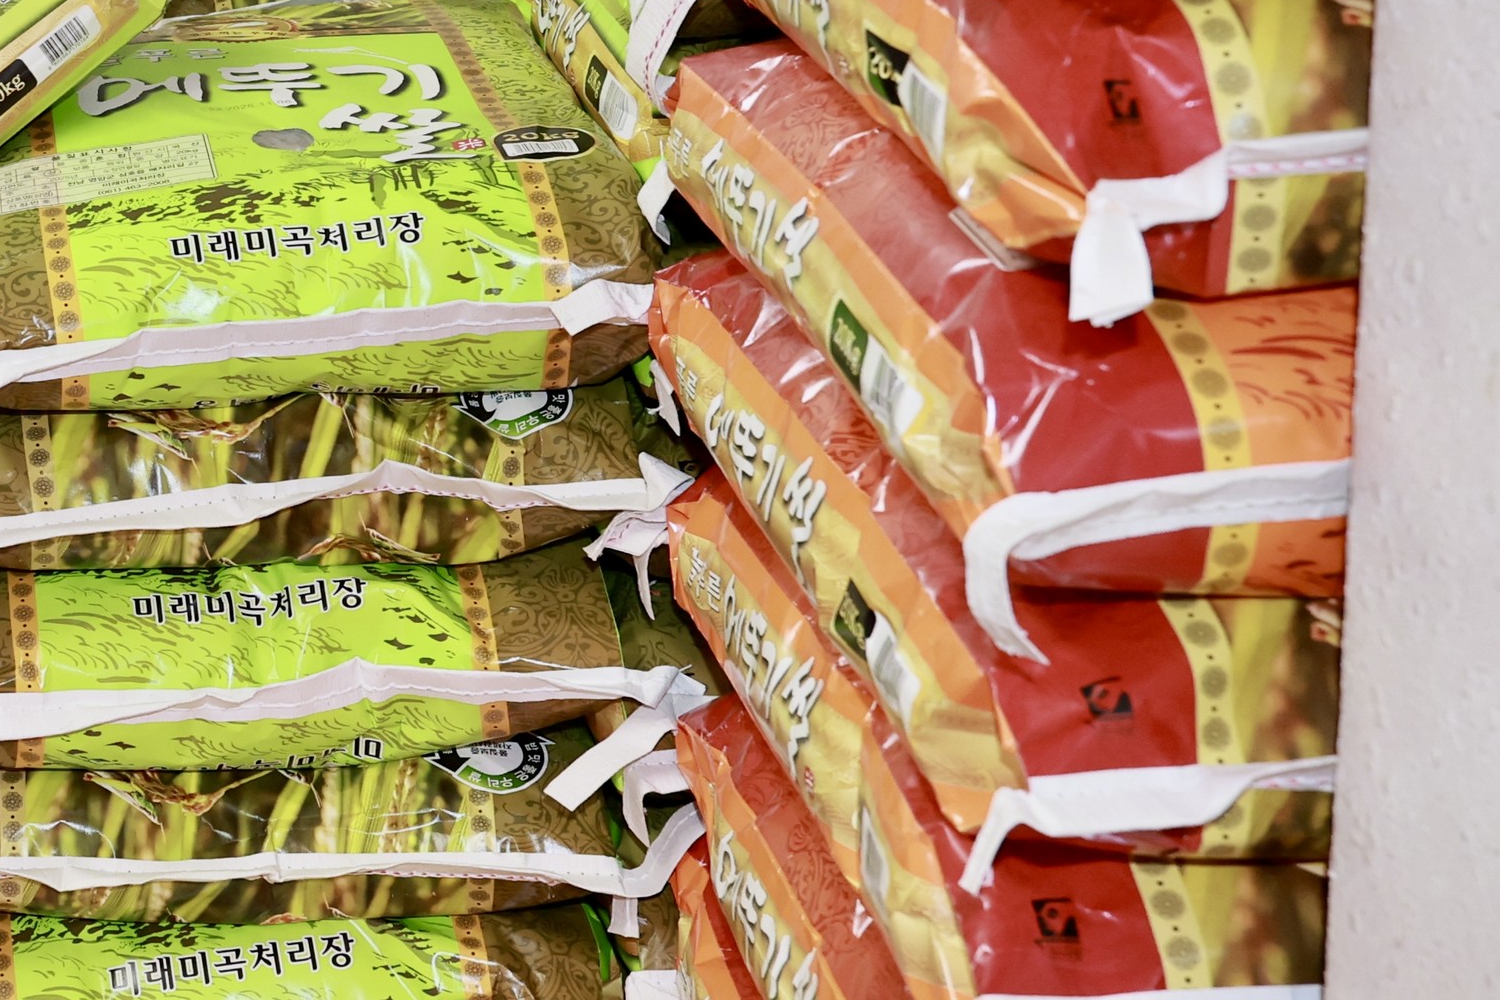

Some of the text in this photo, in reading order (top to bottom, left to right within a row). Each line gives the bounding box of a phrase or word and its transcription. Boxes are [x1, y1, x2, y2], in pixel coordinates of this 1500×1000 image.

[78, 62, 442, 116] 메뚜기
[318, 103, 479, 163] 쌀
[170, 212, 425, 263] 미래미곡처리장
[133, 577, 367, 627] 미래미곡처리장
[108, 932, 356, 996] 미래미곡처리장
